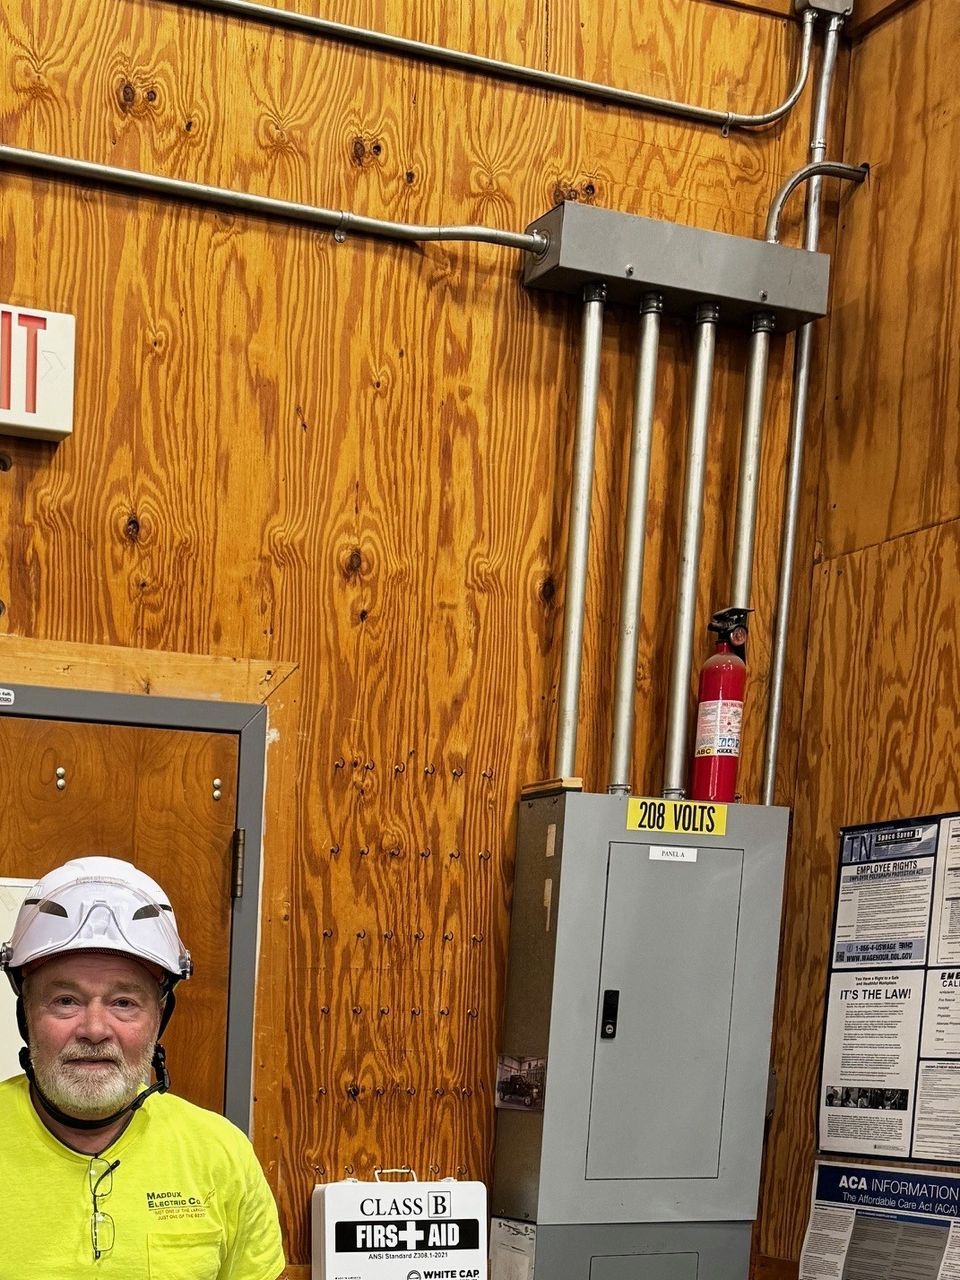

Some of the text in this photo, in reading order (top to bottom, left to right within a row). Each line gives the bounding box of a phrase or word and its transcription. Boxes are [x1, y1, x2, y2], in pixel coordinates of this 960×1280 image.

[638, 801, 716, 832] 208 VOLTS
[847, 833, 872, 862] TN
[857, 860, 918, 874] EMPLOYEE RIGHTS
[840, 988, 911, 1000] IT'S THE LAW!
[146, 1192, 182, 1200] MADDUX
[839, 1175, 959, 1200] ACA INFORMATION
[147, 1200, 187, 1208] ELECTRIC
[360, 1195, 447, 1216] CLASS B
[842, 1192, 958, 1216] The Affordable Care Act (ACA)
[428, 1223, 460, 1247] AID
[423, 1270, 457, 1279] WHITE
